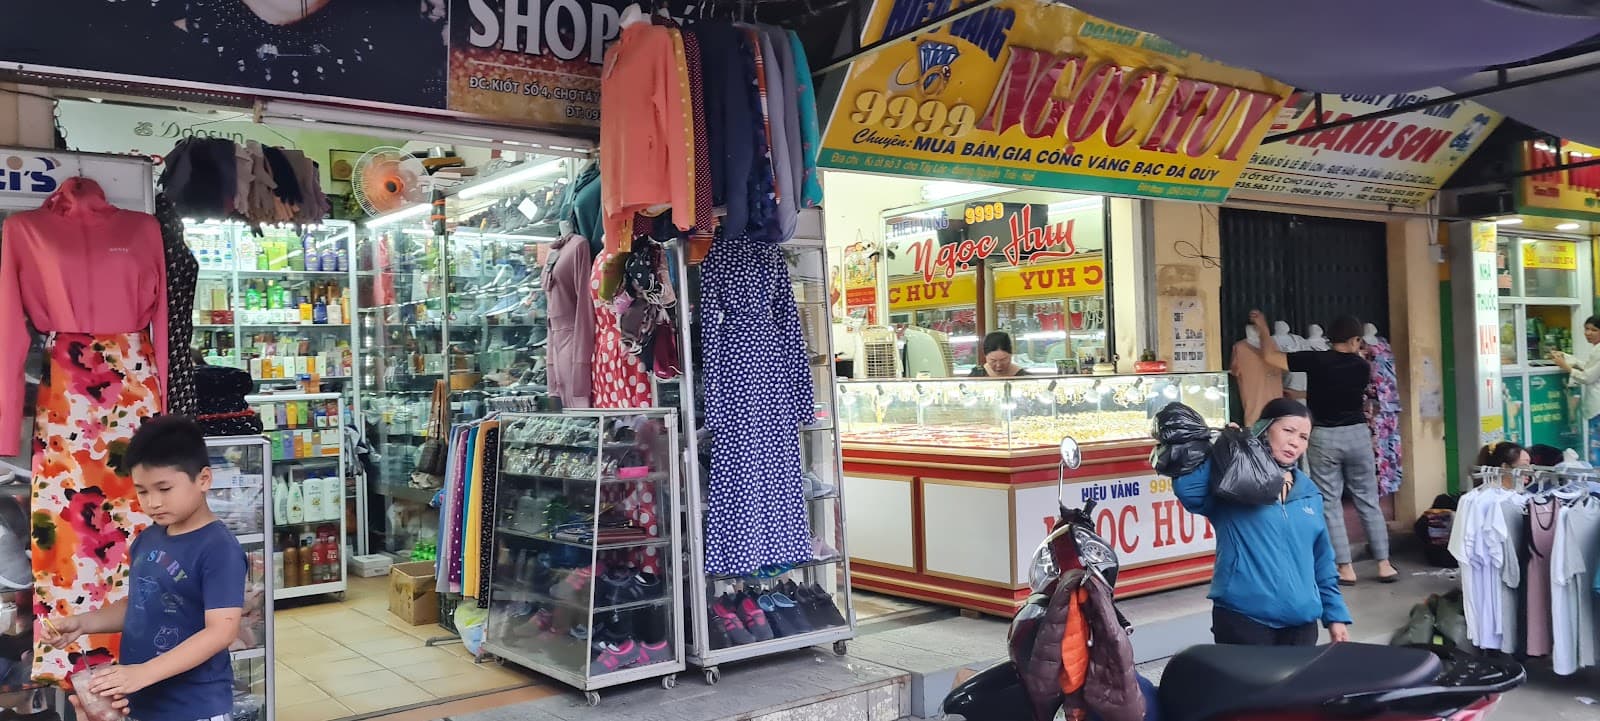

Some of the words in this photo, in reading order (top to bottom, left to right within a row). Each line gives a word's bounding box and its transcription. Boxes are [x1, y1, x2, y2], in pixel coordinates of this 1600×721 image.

[469, 0, 621, 64] SHOP
[851, 90, 976, 138] 9999
[976, 46, 1158, 155] NGỌC
[1139, 72, 1283, 161] HUY
[913, 135, 954, 155] MUA
[964, 202, 1004, 225] 9999
[905, 235, 999, 284] Ngọc
[1002, 203, 1076, 267] Huy
[906, 283, 953, 302] HUY
[1111, 481, 1140, 499] VÀNG
